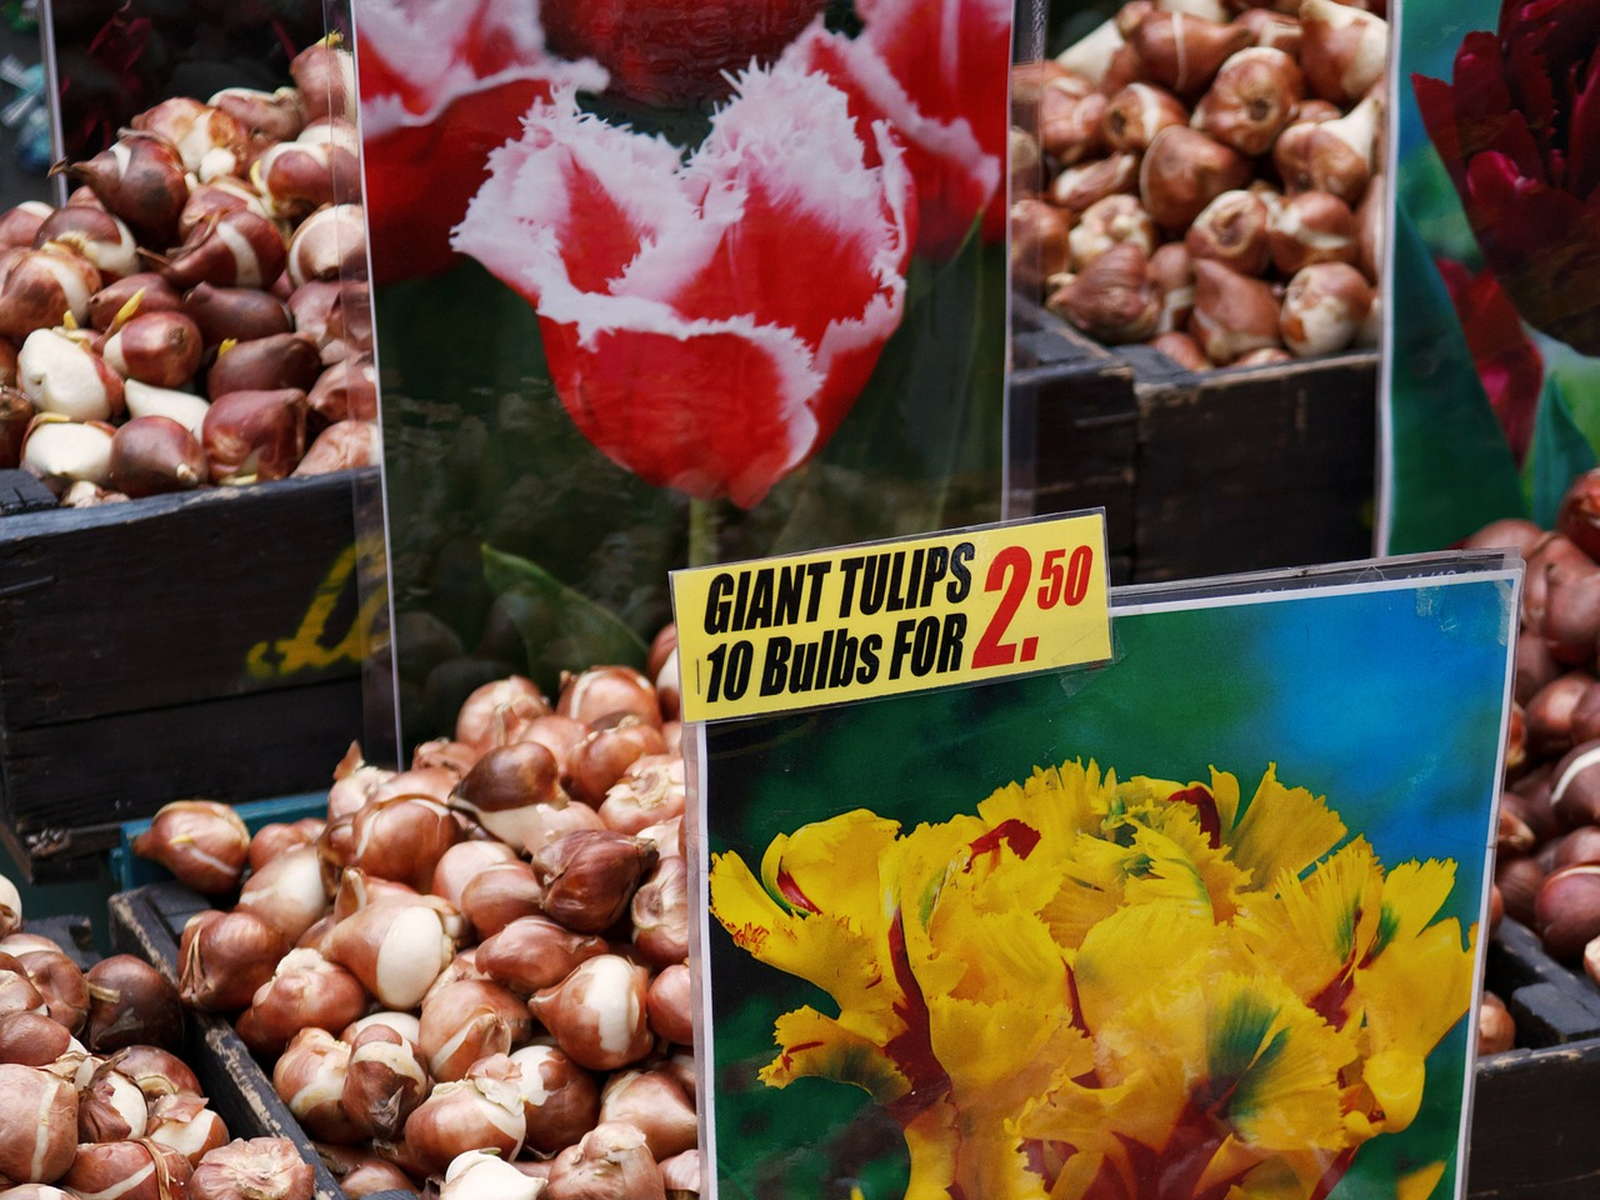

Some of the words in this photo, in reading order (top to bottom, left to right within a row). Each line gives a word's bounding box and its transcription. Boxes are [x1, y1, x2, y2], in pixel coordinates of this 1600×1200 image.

[704, 561, 833, 635] GIANT
[838, 542, 976, 619] TULIPS
[706, 640, 754, 703] 10
[760, 628, 883, 697] Bulbs
[888, 613, 968, 681] FOR
